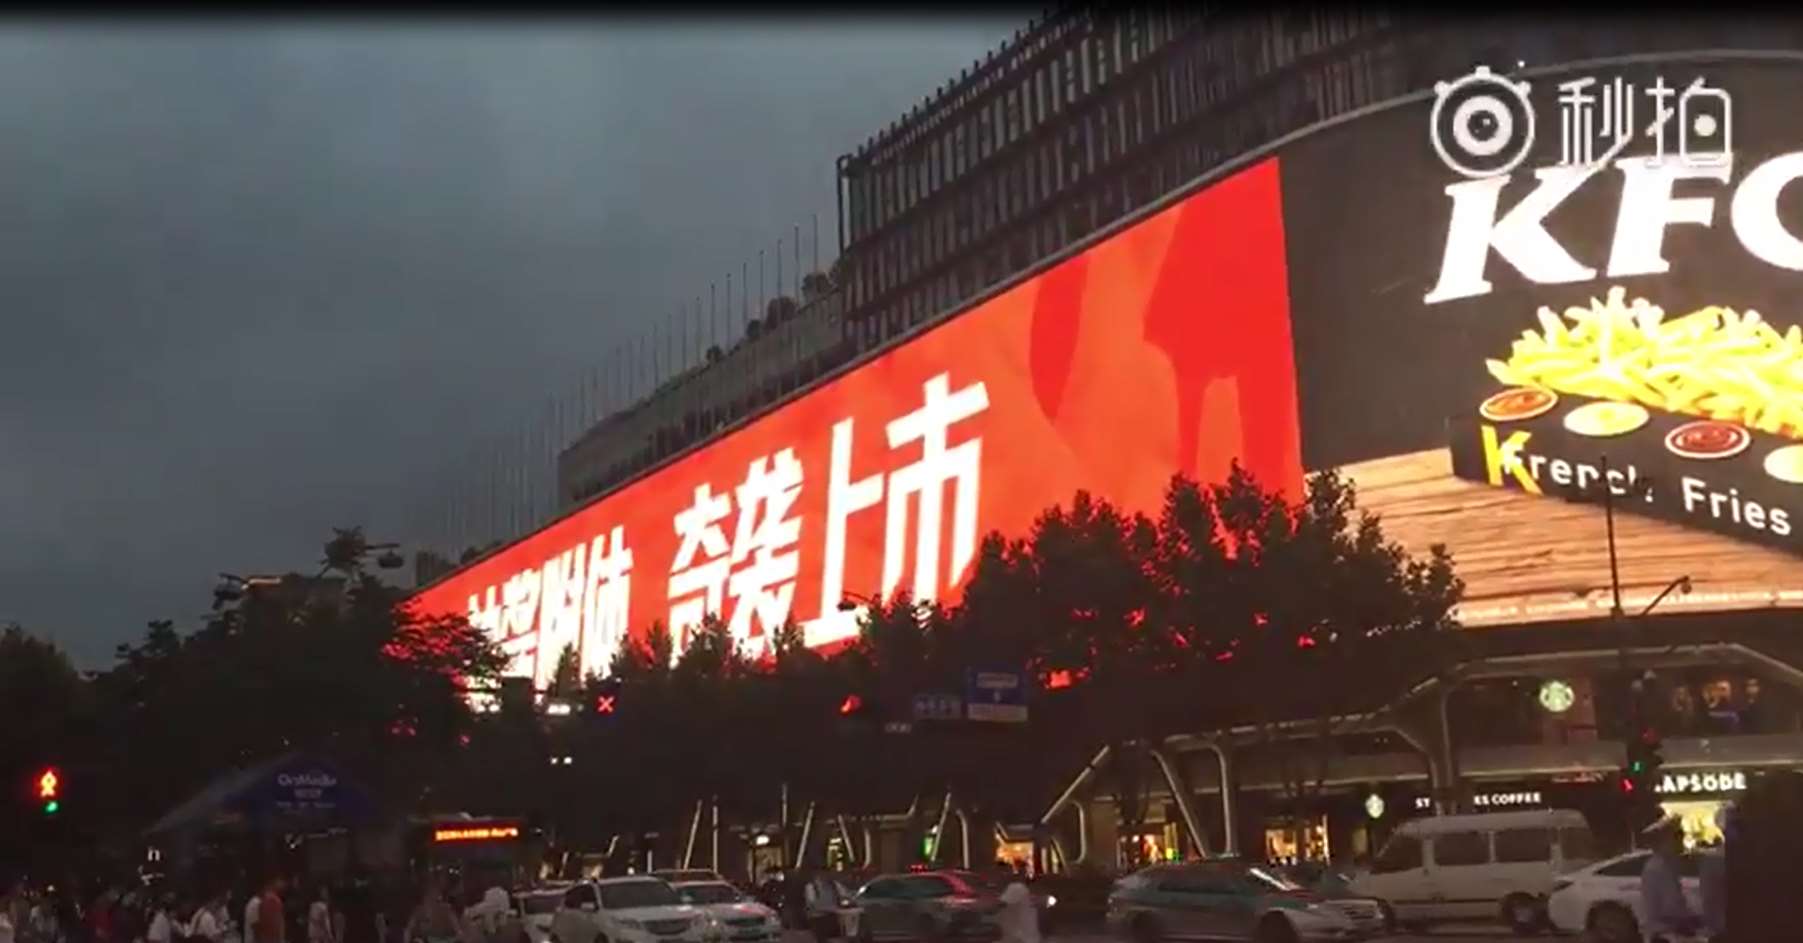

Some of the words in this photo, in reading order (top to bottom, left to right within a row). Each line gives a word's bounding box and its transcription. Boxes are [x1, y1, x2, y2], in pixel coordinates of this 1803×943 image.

[1424, 153, 1803, 305] KFC
[668, 371, 990, 668] 奇袭上市
[1681, 476, 1793, 537] Fries
[1491, 792, 1542, 806] COFFEE
[1654, 772, 1747, 793] APSODE
